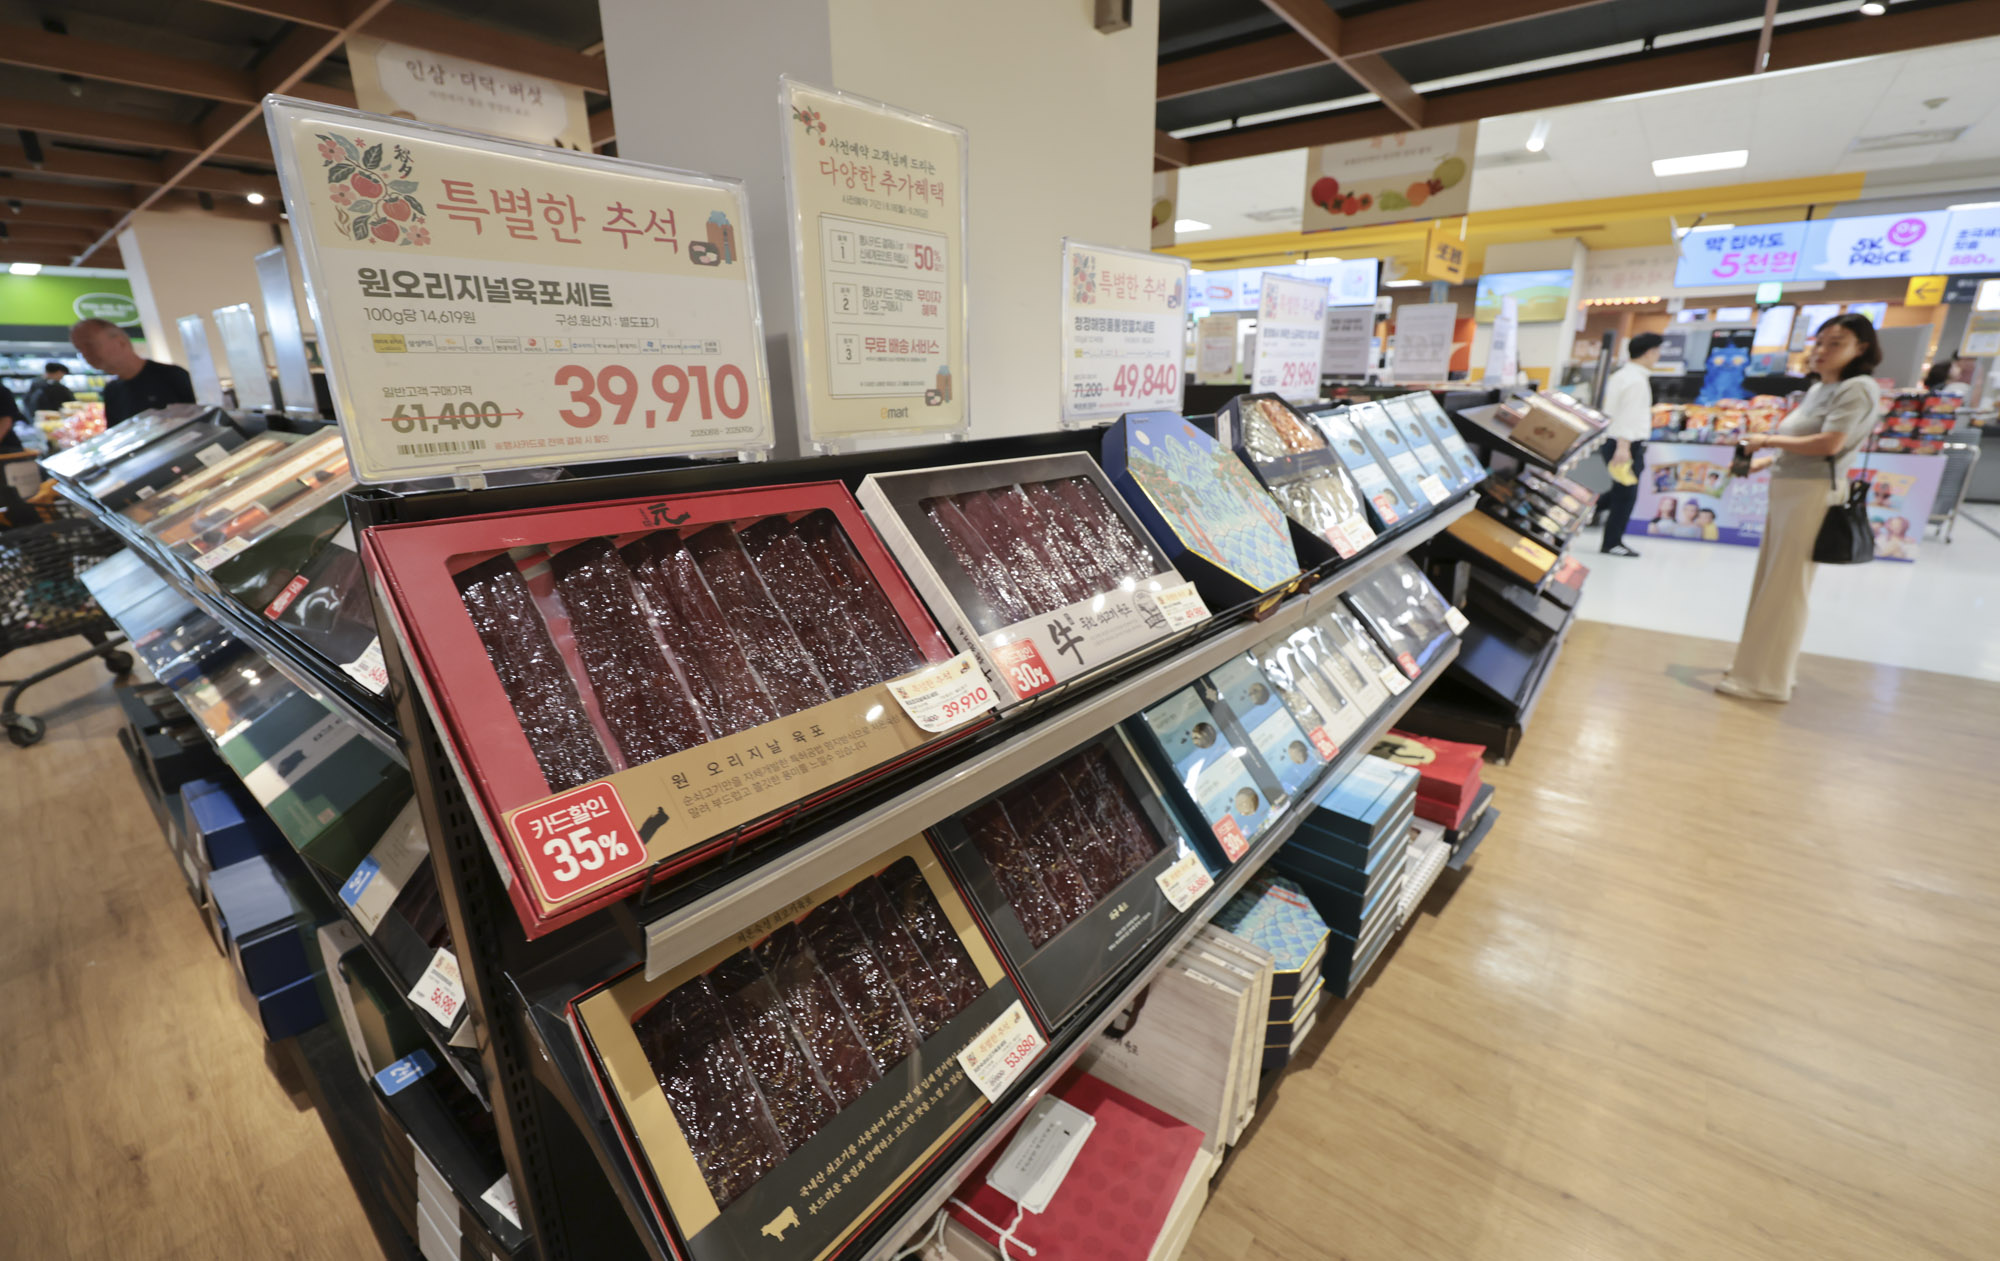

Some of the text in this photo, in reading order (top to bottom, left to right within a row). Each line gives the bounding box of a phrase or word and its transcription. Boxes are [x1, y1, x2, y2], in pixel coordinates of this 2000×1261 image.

[819, 156, 944, 207] 다양한 추가혜택
[436, 178, 679, 254] 특별한 추석
[914, 244, 934, 271] 50
[1851, 237, 1883, 252] 5K
[1712, 250, 1798, 278] 5천원
[357, 267, 613, 308] 원오리지널육포세트
[364, 307, 477, 325] 100g당 14,619원
[619, 316, 660, 329] 별도표기
[864, 337, 940, 354] 무료 배송 서비스
[382, 385, 473, 398] 일반고객 구매가격
[555, 363, 750, 430] 39,910
[1113, 363, 1177, 399] 49,840
[391, 401, 502, 434] 61,400
[881, 406, 909, 420] emart
[1010, 661, 1050, 692] 30%
[942, 686, 988, 719] 39,910
[671, 772, 690, 790] 원
[528, 795, 611, 840] 카드할인
[543, 826, 629, 882] 35%
[1004, 1034, 1036, 1068] 53,880
